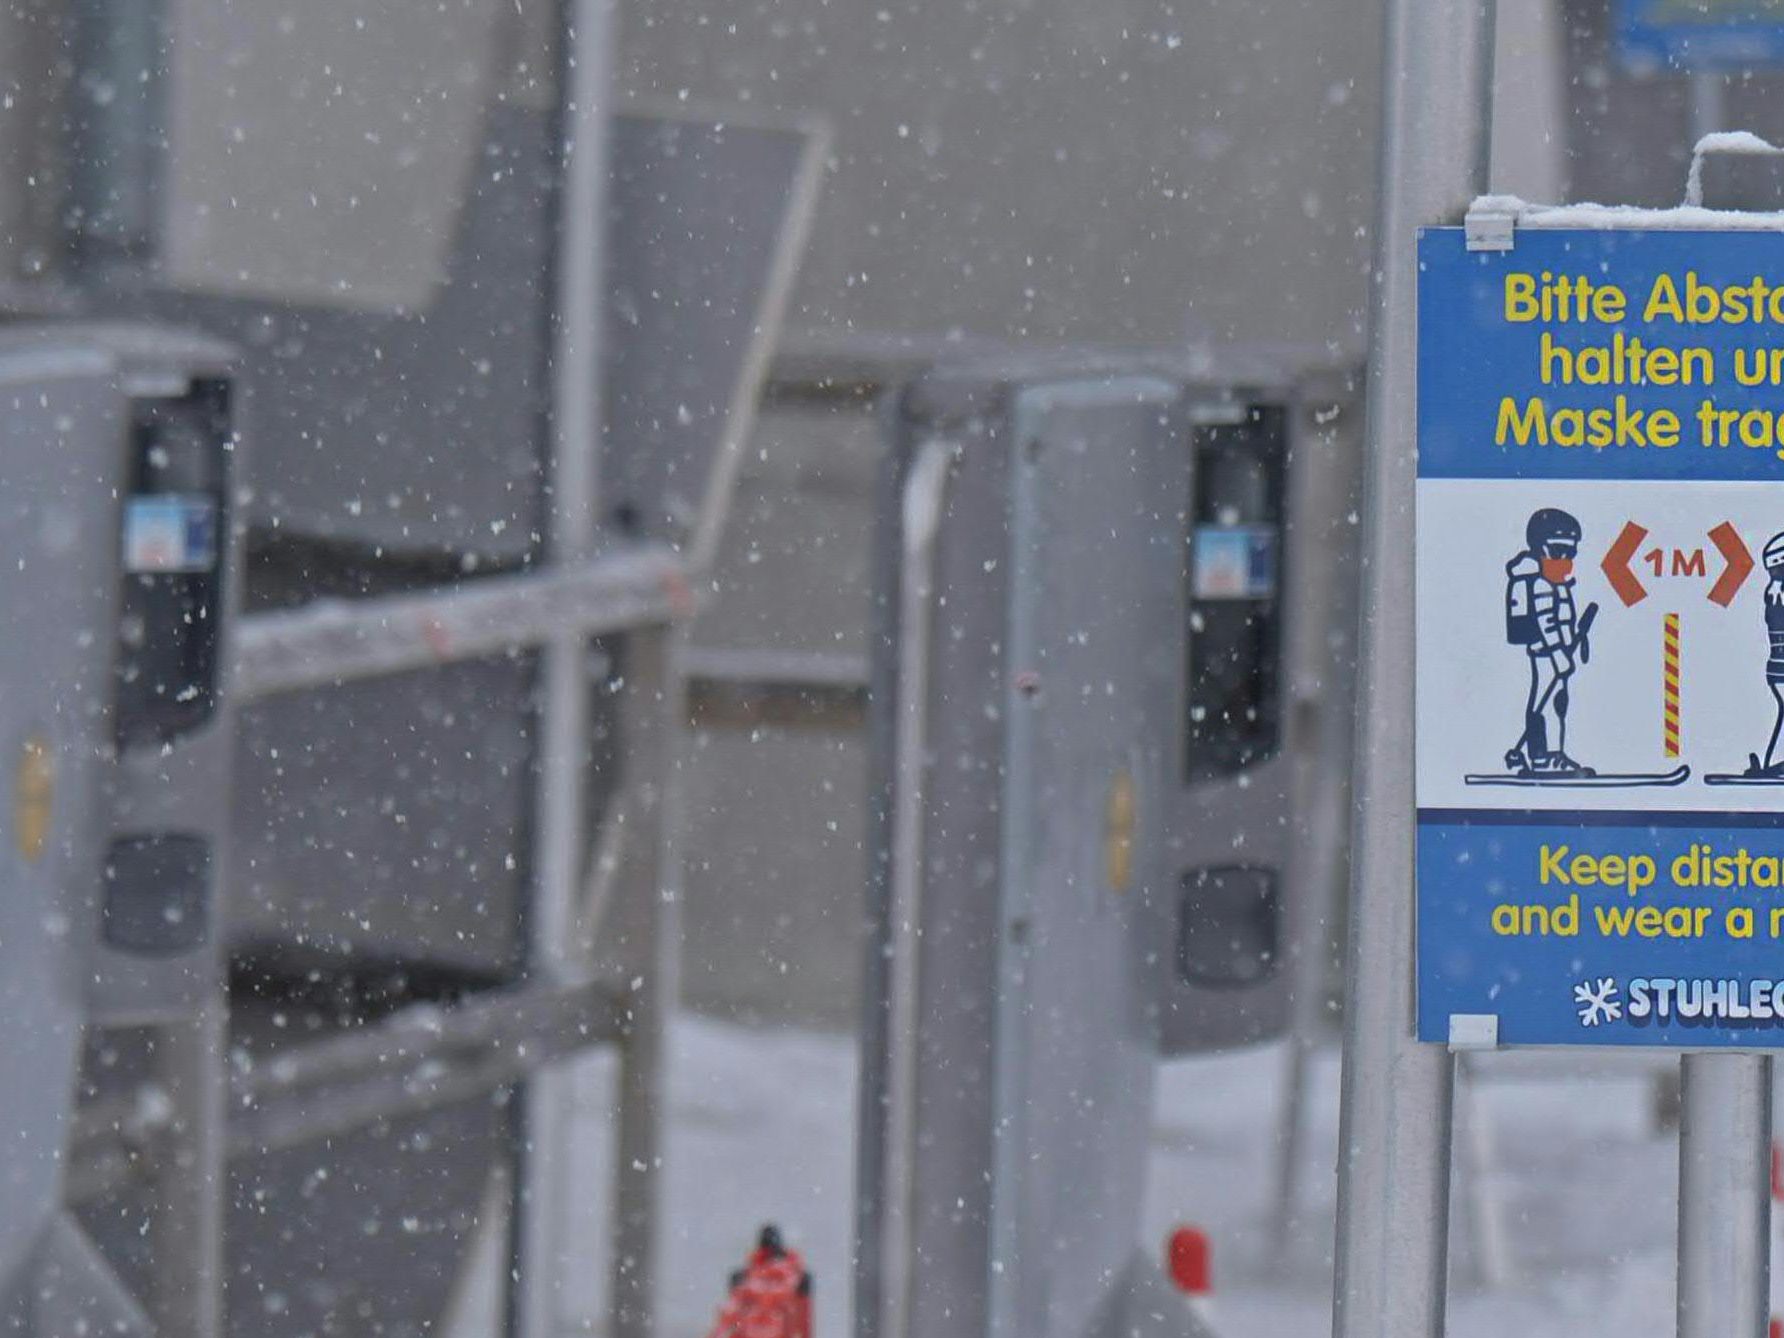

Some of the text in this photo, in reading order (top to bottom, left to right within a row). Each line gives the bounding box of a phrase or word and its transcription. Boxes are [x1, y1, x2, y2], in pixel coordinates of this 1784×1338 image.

[1504, 270, 1627, 323] Bitte
[1540, 331, 1715, 385] halten
[1495, 394, 1681, 448] Maske
[1644, 548, 1706, 577] 1M
[1540, 844, 1657, 896] Keep
[1491, 893, 1580, 937] and
[1594, 905, 1713, 938] wear
[1725, 907, 1755, 939] a
